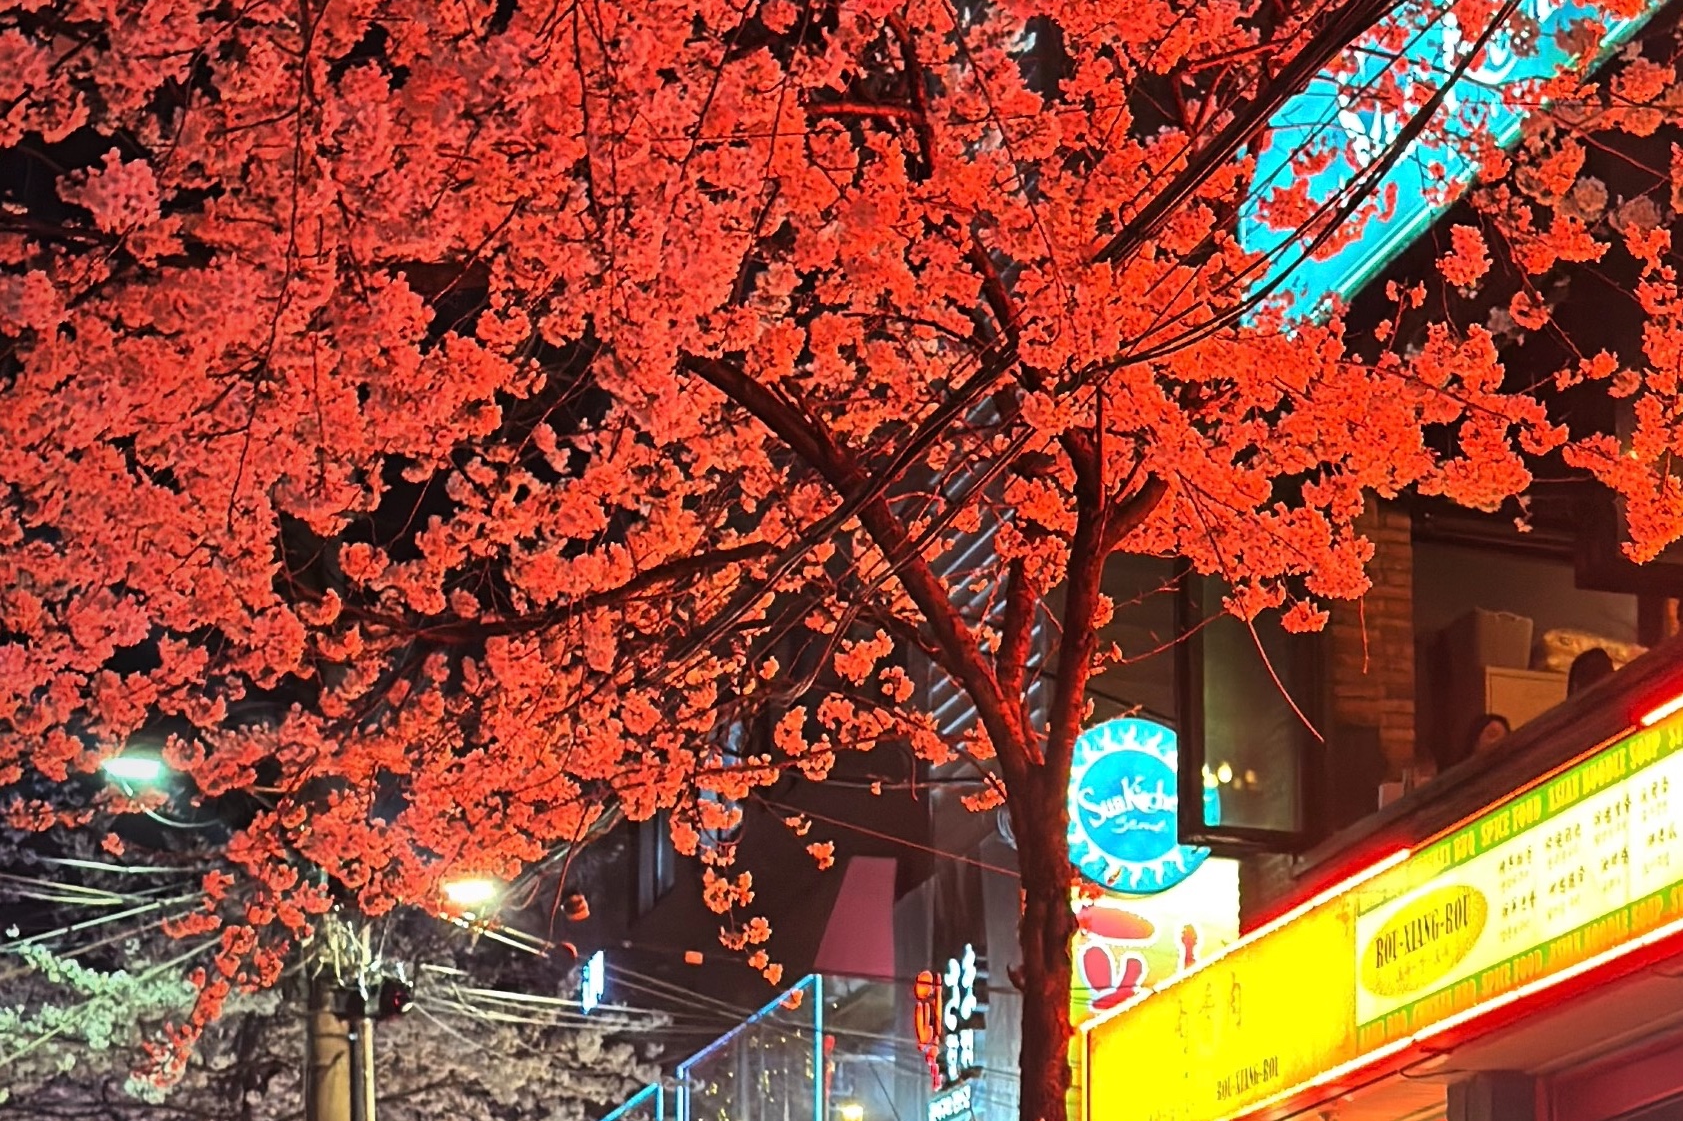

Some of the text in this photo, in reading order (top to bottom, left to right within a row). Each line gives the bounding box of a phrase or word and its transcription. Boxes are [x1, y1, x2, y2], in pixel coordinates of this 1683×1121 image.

[1511, 794, 1542, 832] FOOD
[1582, 747, 1626, 795] NOODLE
[1629, 730, 1662, 769] SOUP
[1512, 950, 1543, 984] FOOD
[1584, 909, 1629, 955] NOODLE
[1630, 894, 1663, 933] SOUP
